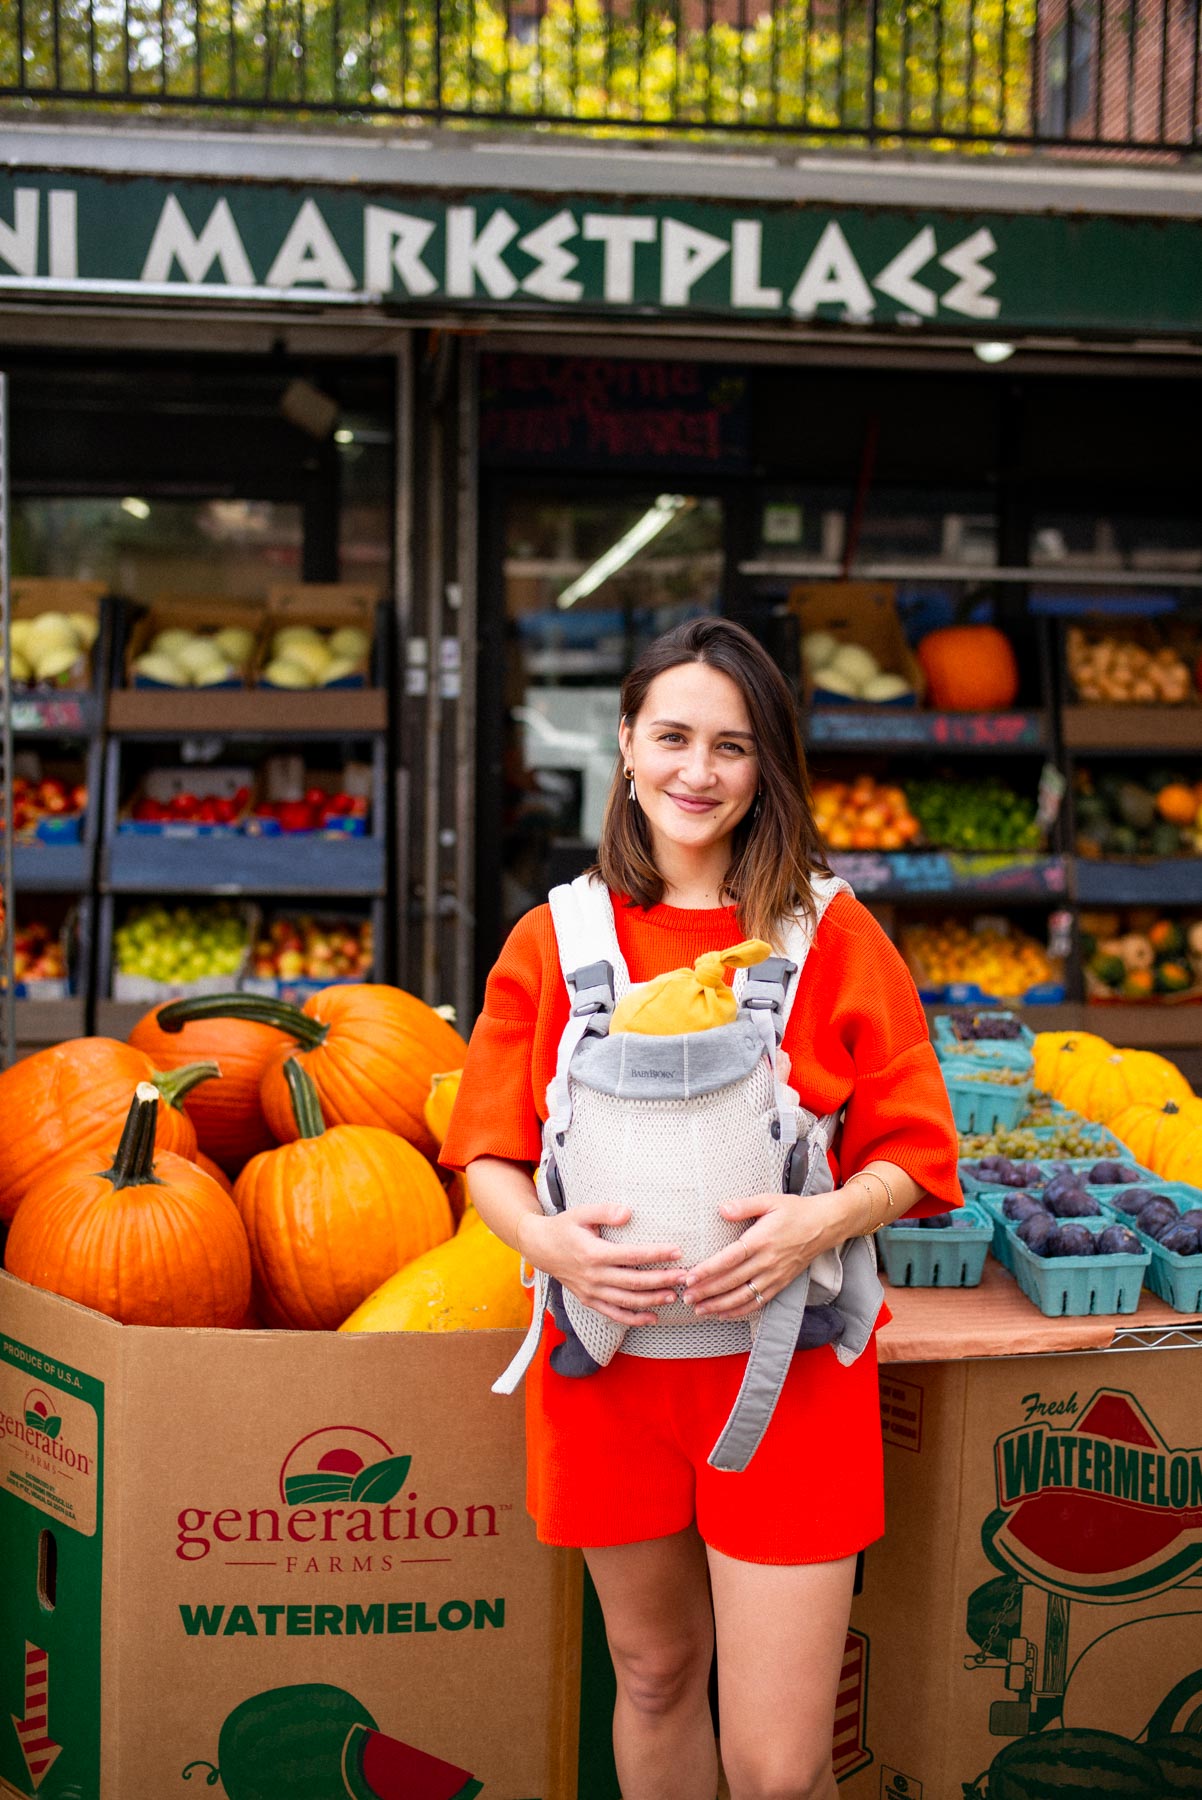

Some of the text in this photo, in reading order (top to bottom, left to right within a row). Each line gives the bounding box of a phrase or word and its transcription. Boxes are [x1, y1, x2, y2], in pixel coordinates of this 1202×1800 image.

[0, 187, 1001, 320] NI MARKETPLACE
[3, 1341, 84, 1390] PRODUCE OF U.S.A.
[1020, 1391, 1079, 1422] Fresh
[24, 1450, 57, 1475] FARMS
[1003, 1429, 1202, 1509] WATERMELON
[175, 1492, 500, 1561] generation
[285, 1554, 394, 1573] FARMS
[178, 1598, 505, 1636] WATERMELON
